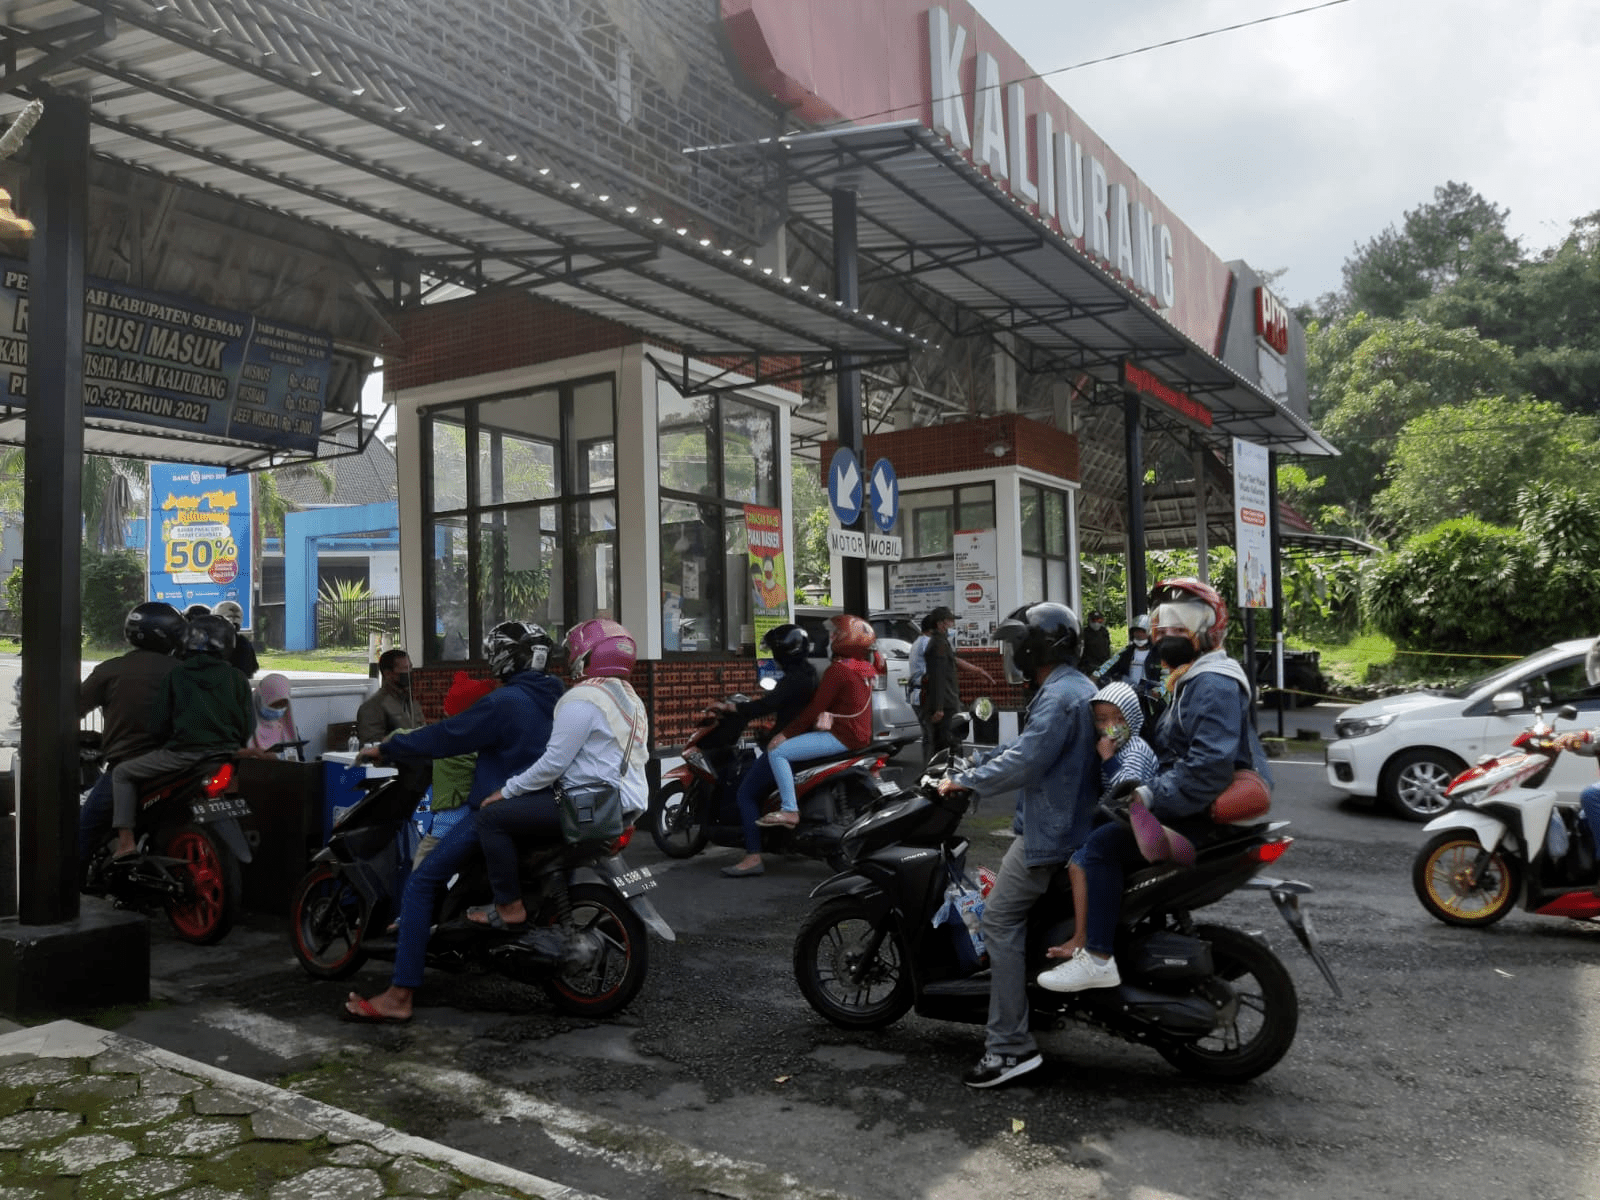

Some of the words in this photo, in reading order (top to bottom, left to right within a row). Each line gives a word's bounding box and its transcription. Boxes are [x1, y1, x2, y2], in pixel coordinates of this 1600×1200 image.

[929, 6, 1175, 311] KALIURANG
[110, 293, 191, 325] KABUPATEN
[192, 314, 244, 338] SLEMAN
[145, 325, 228, 369] MASUK
[85, 353, 118, 379] ISATA
[119, 360, 154, 385] ALAM
[155, 367, 227, 399] KALIURANG
[124, 392, 173, 416] TAHUN
[175, 401, 208, 422] 2021
[170, 539, 235, 569] 50%
[761, 530, 779, 549] MASKER
[831, 533, 864, 552] MOTOR
[870, 539, 899, 557] MOBIL
[612, 876, 625, 888] AB
